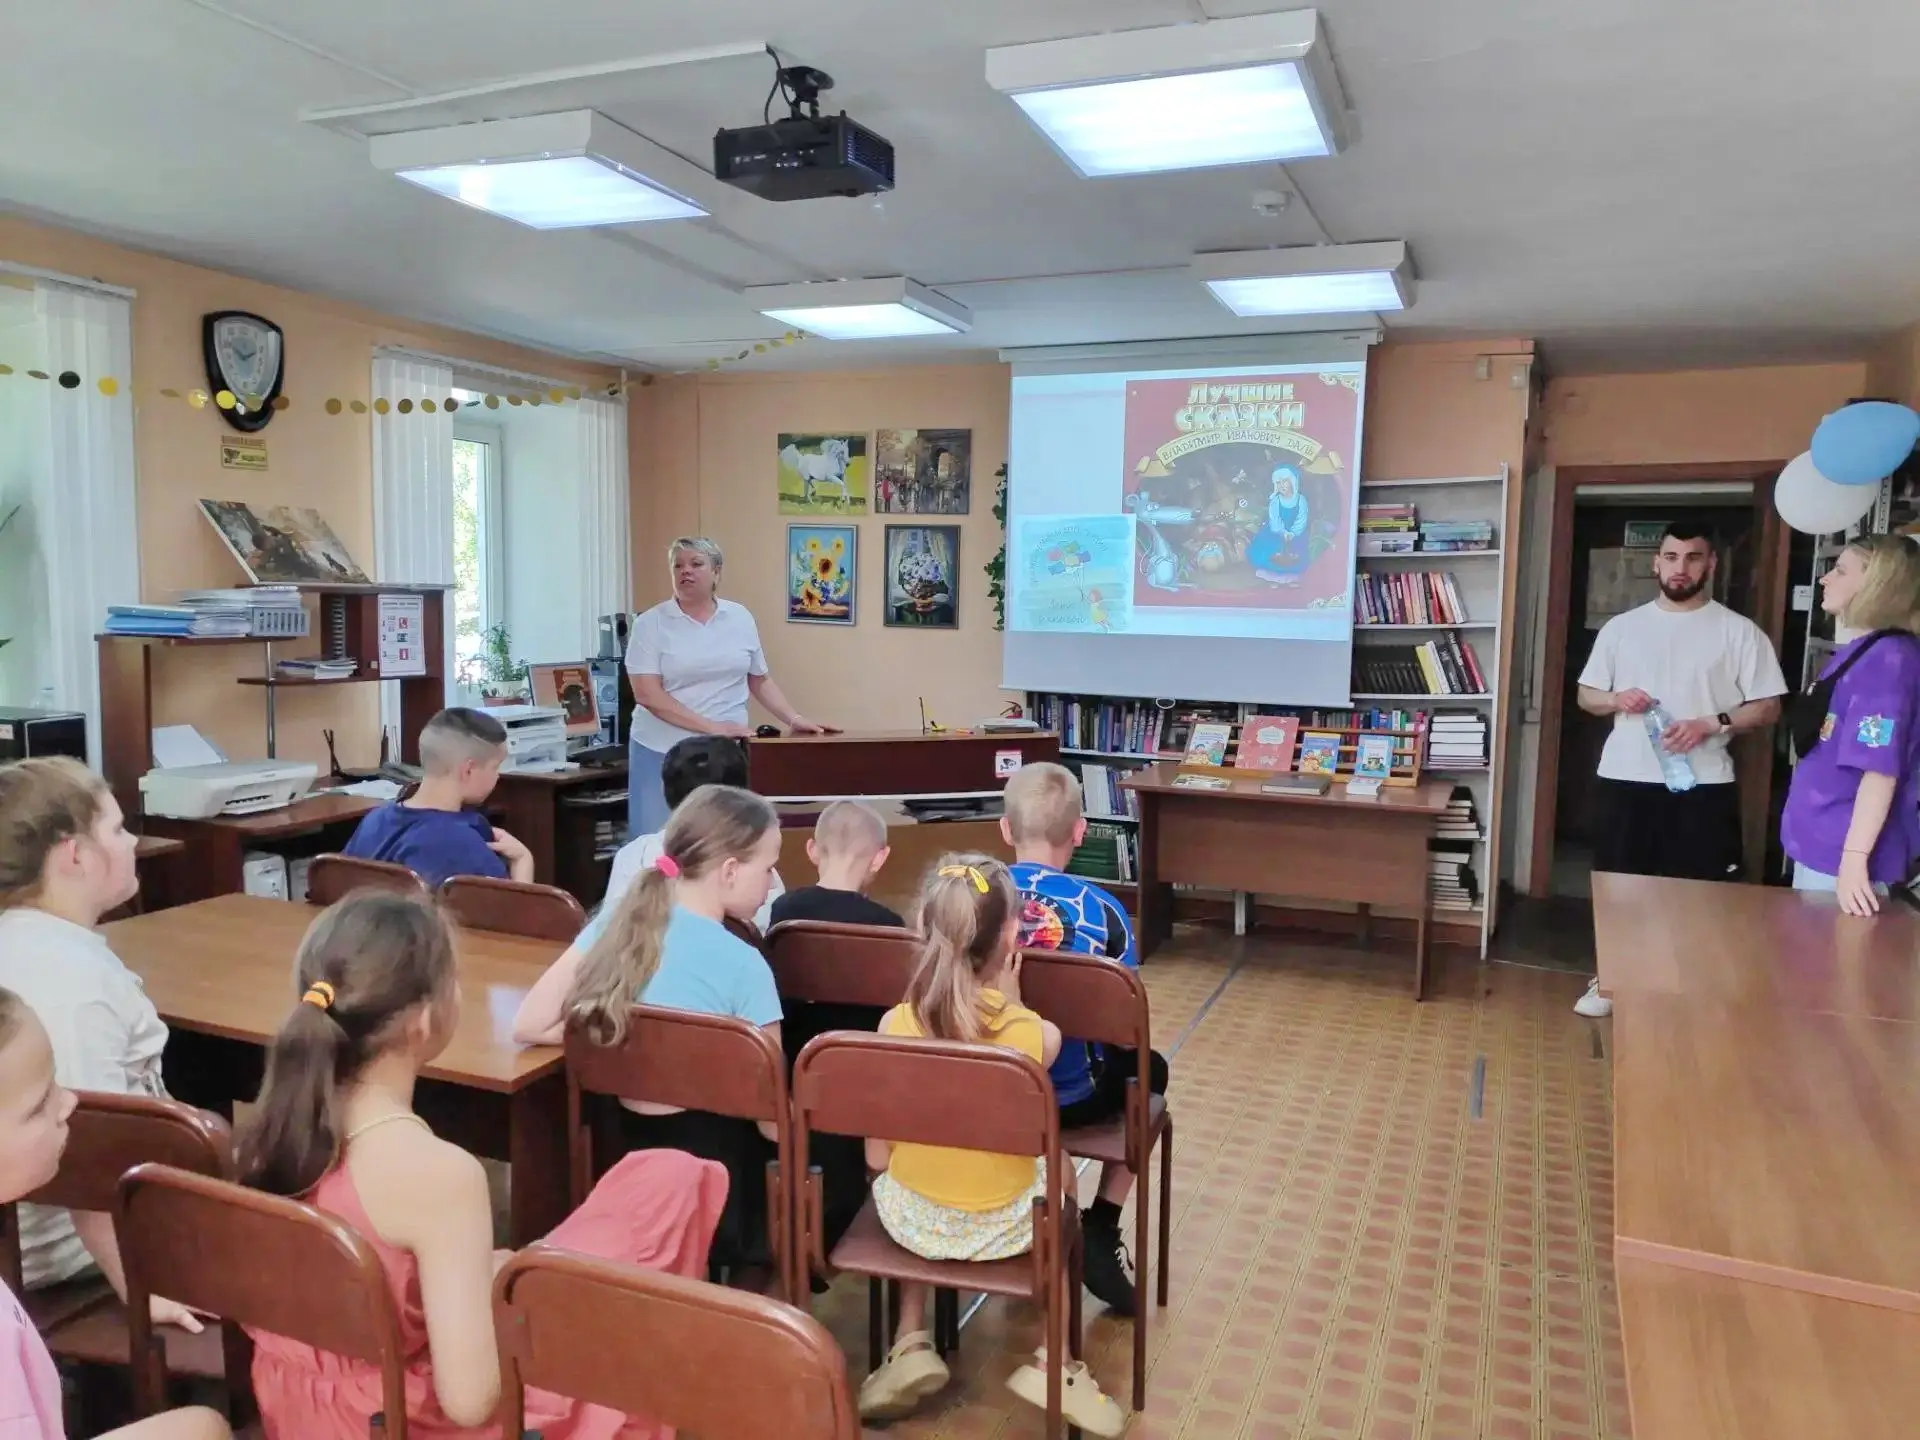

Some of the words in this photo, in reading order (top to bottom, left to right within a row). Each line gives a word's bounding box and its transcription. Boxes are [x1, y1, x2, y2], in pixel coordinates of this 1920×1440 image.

[1175, 402, 1305, 431] СКАЗКИ
[1162, 432, 1221, 461] ВЛАДИМИР
[1227, 430, 1281, 443] ИВАНОВИЧ
[1287, 439, 1314, 457] ДАЛЬ
